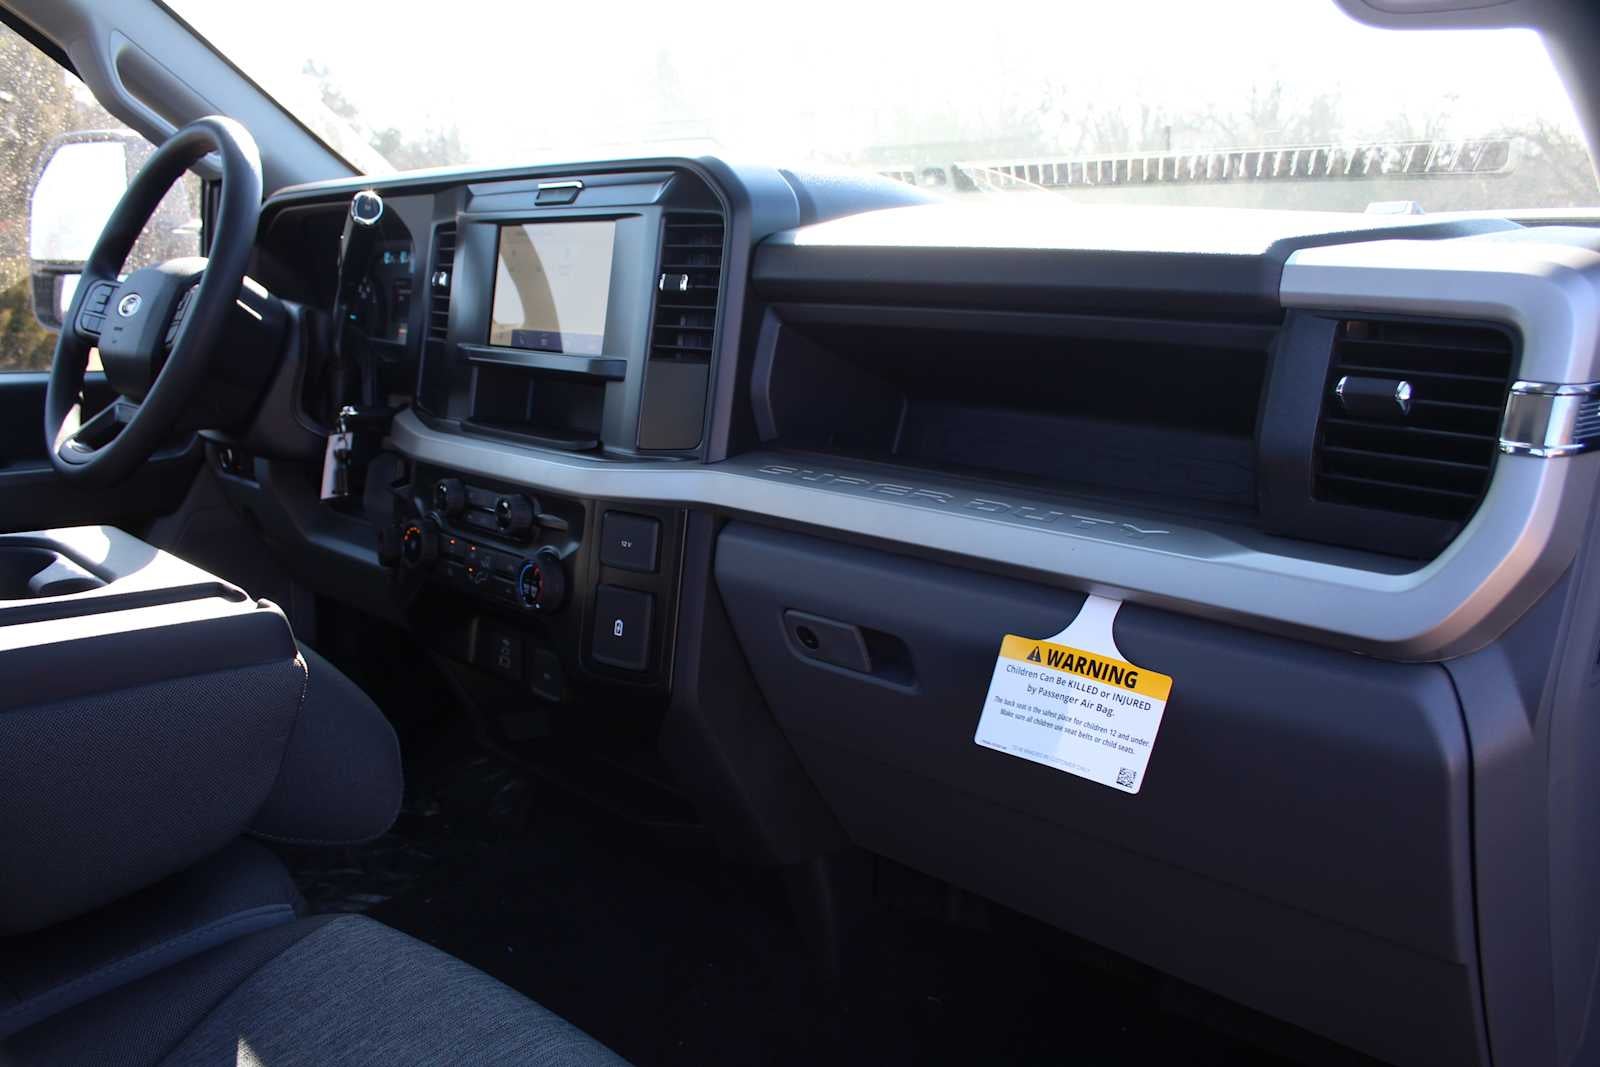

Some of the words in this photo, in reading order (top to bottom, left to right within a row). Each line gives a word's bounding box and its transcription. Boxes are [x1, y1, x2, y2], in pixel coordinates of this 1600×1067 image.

[964, 496, 1171, 537] DUTY
[1007, 664, 1038, 679] Children
[1040, 673, 1054, 682] Can
[1056, 677, 1066, 685] Be
[1068, 680, 1098, 695] KILLED
[1101, 690, 1109, 698] or
[1112, 693, 1151, 711] INJURED
[1047, 649, 1139, 688] WARNING
[1027, 685, 1036, 694] by
[1038, 687, 1079, 706] Passenger
[1081, 699, 1094, 709] Air
[1096, 703, 1115, 717] Bag.
[1001, 708, 1013, 717] Make
[1034, 718, 1053, 728] children
[1064, 727, 1076, 735] seat
[1078, 731, 1093, 740] belts
[1103, 738, 1117, 748] child
[1042, 709, 1056, 718] safest
[1057, 713, 1071, 723] place
[1074, 718, 1082, 726] for
[1083, 721, 1107, 733] children
[1118, 732, 1129, 740] and
